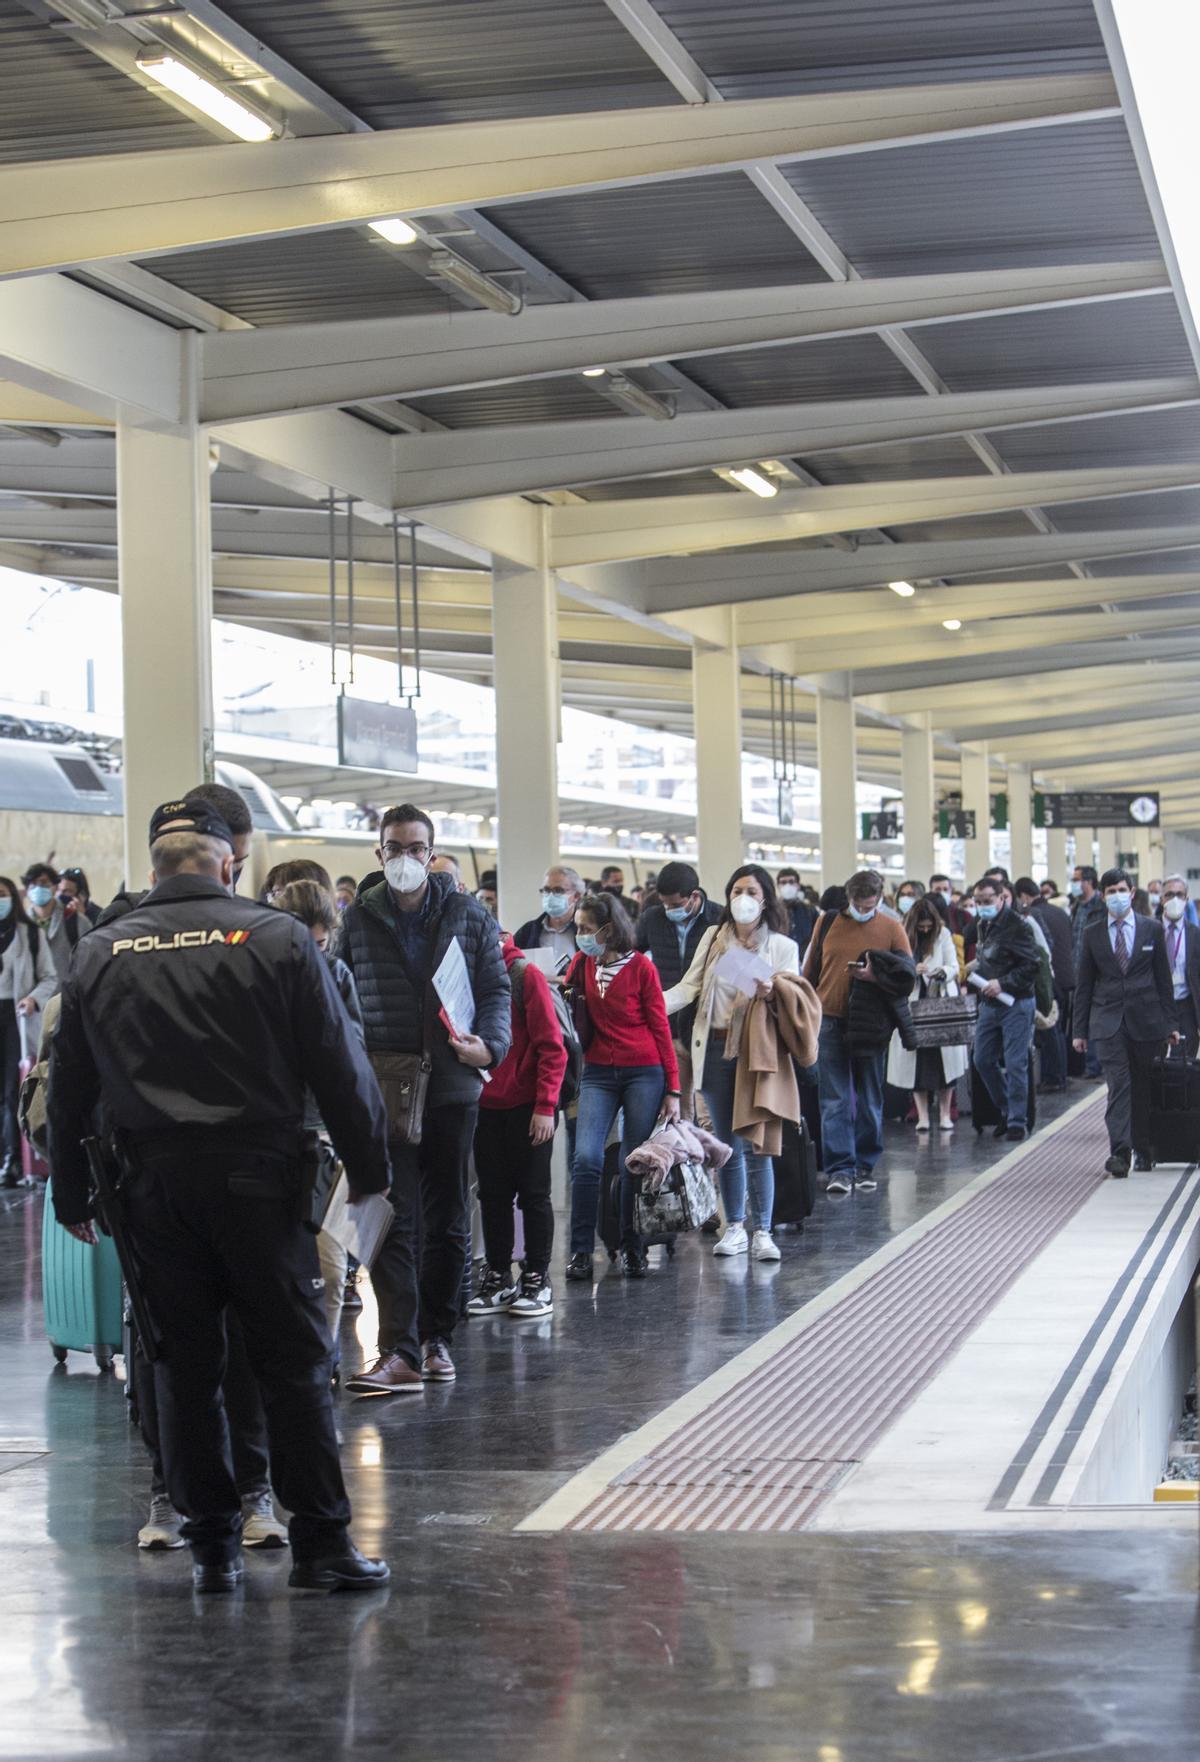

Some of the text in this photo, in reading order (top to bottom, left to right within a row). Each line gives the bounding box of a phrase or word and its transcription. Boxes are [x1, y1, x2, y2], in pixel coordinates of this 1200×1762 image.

[1043, 810, 1053, 826] 3
[870, 824, 896, 840] A 4
[948, 823, 974, 838] A 3
[112, 929, 226, 956] POLICIA
